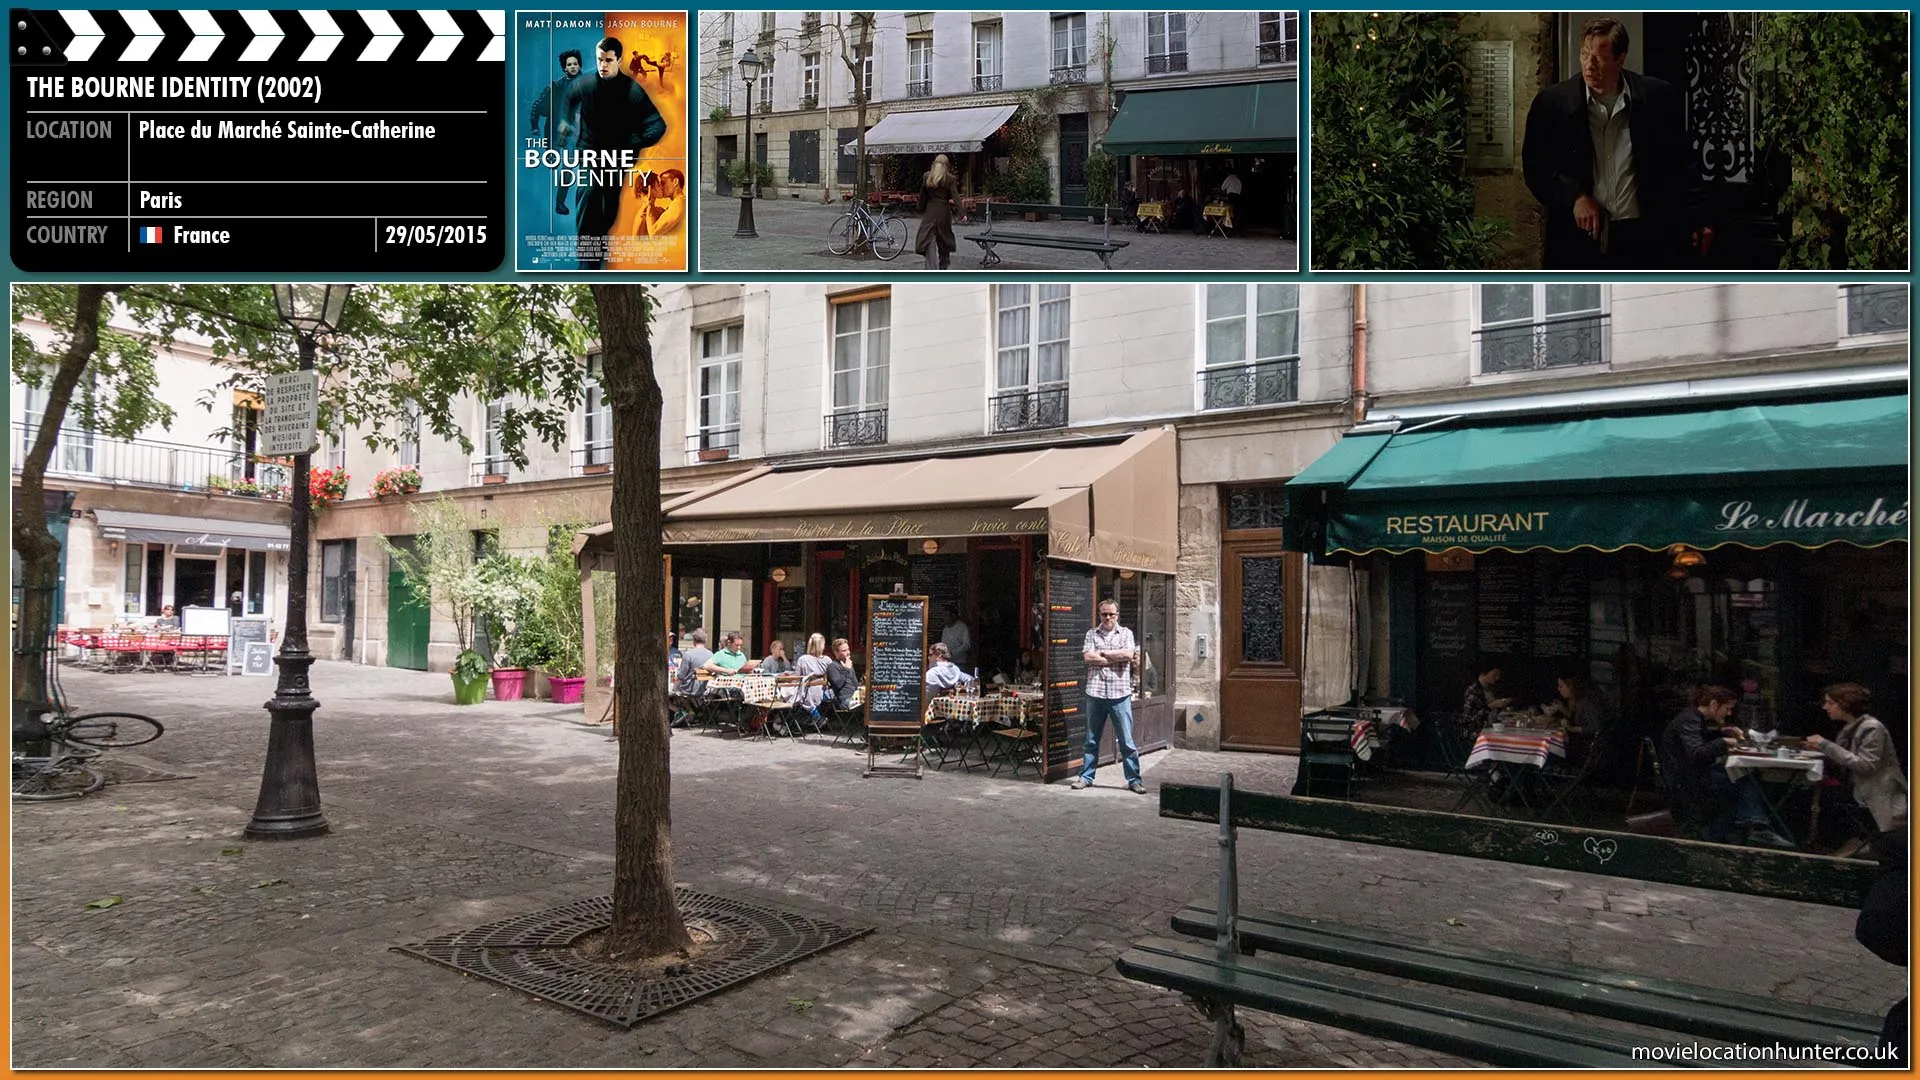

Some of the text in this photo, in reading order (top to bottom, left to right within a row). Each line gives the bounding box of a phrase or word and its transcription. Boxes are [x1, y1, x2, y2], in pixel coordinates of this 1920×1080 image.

[526, 20, 678, 28] MATT DAMON IS JASON BOURNE
[525, 138, 548, 148] THE
[928, 144, 949, 152] PLACE
[525, 149, 634, 168] BOURNE
[554, 169, 652, 187] IDENTITY
[279, 375, 300, 384] MERCI
[266, 383, 311, 396] DE RESPECTER
[281, 405, 295, 413] SITE
[298, 402, 306, 411] ET
[265, 416, 272, 424] LA
[278, 422, 310, 432] RIVERAINS
[271, 432, 301, 442] MUSIQUE
[269, 442, 303, 452] INTERDITE
[1715, 497, 1908, 531] Le Marché
[792, 519, 836, 537] Bistrot
[839, 520, 853, 536] de
[858, 520, 875, 535] la
[885, 515, 924, 536] Place
[968, 518, 1010, 533] Service
[1387, 511, 1550, 535] RESTAURANT
[1056, 530, 1083, 555] Café
[1422, 534, 1508, 544] MAISON DE QUALITÉ
